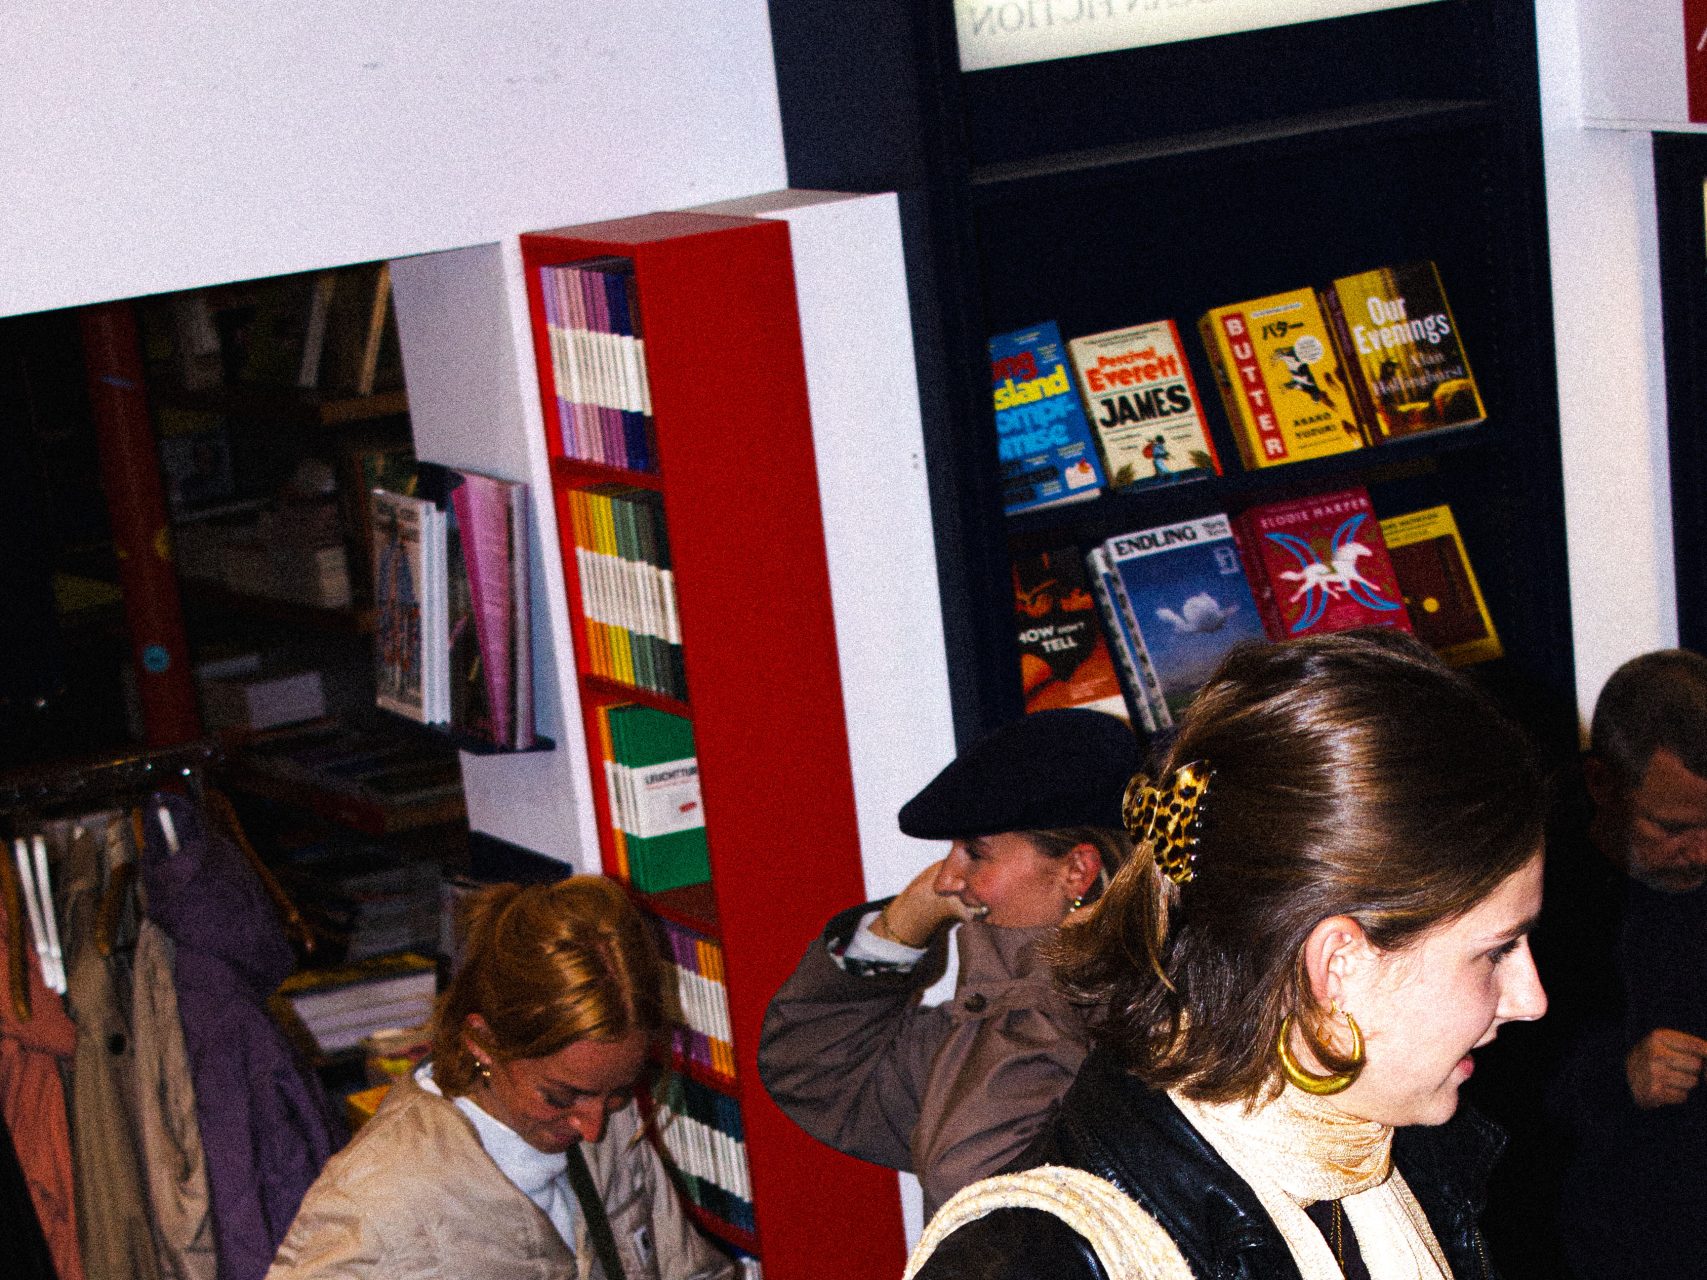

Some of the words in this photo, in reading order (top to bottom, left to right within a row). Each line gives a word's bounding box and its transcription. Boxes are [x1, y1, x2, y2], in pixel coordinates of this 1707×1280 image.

[1367, 296, 1407, 327] Our
[1261, 320, 1305, 341] バター
[1352, 313, 1451, 356] Evenings
[1085, 354, 1179, 393] Everett
[1097, 346, 1157, 369] Percival
[993, 364, 1071, 411] sland
[1225, 318, 1285, 457] BUTTER
[1100, 384, 1192, 428] JAMES
[1113, 525, 1199, 557] ENDLING
[1041, 634, 1079, 653] TELL
